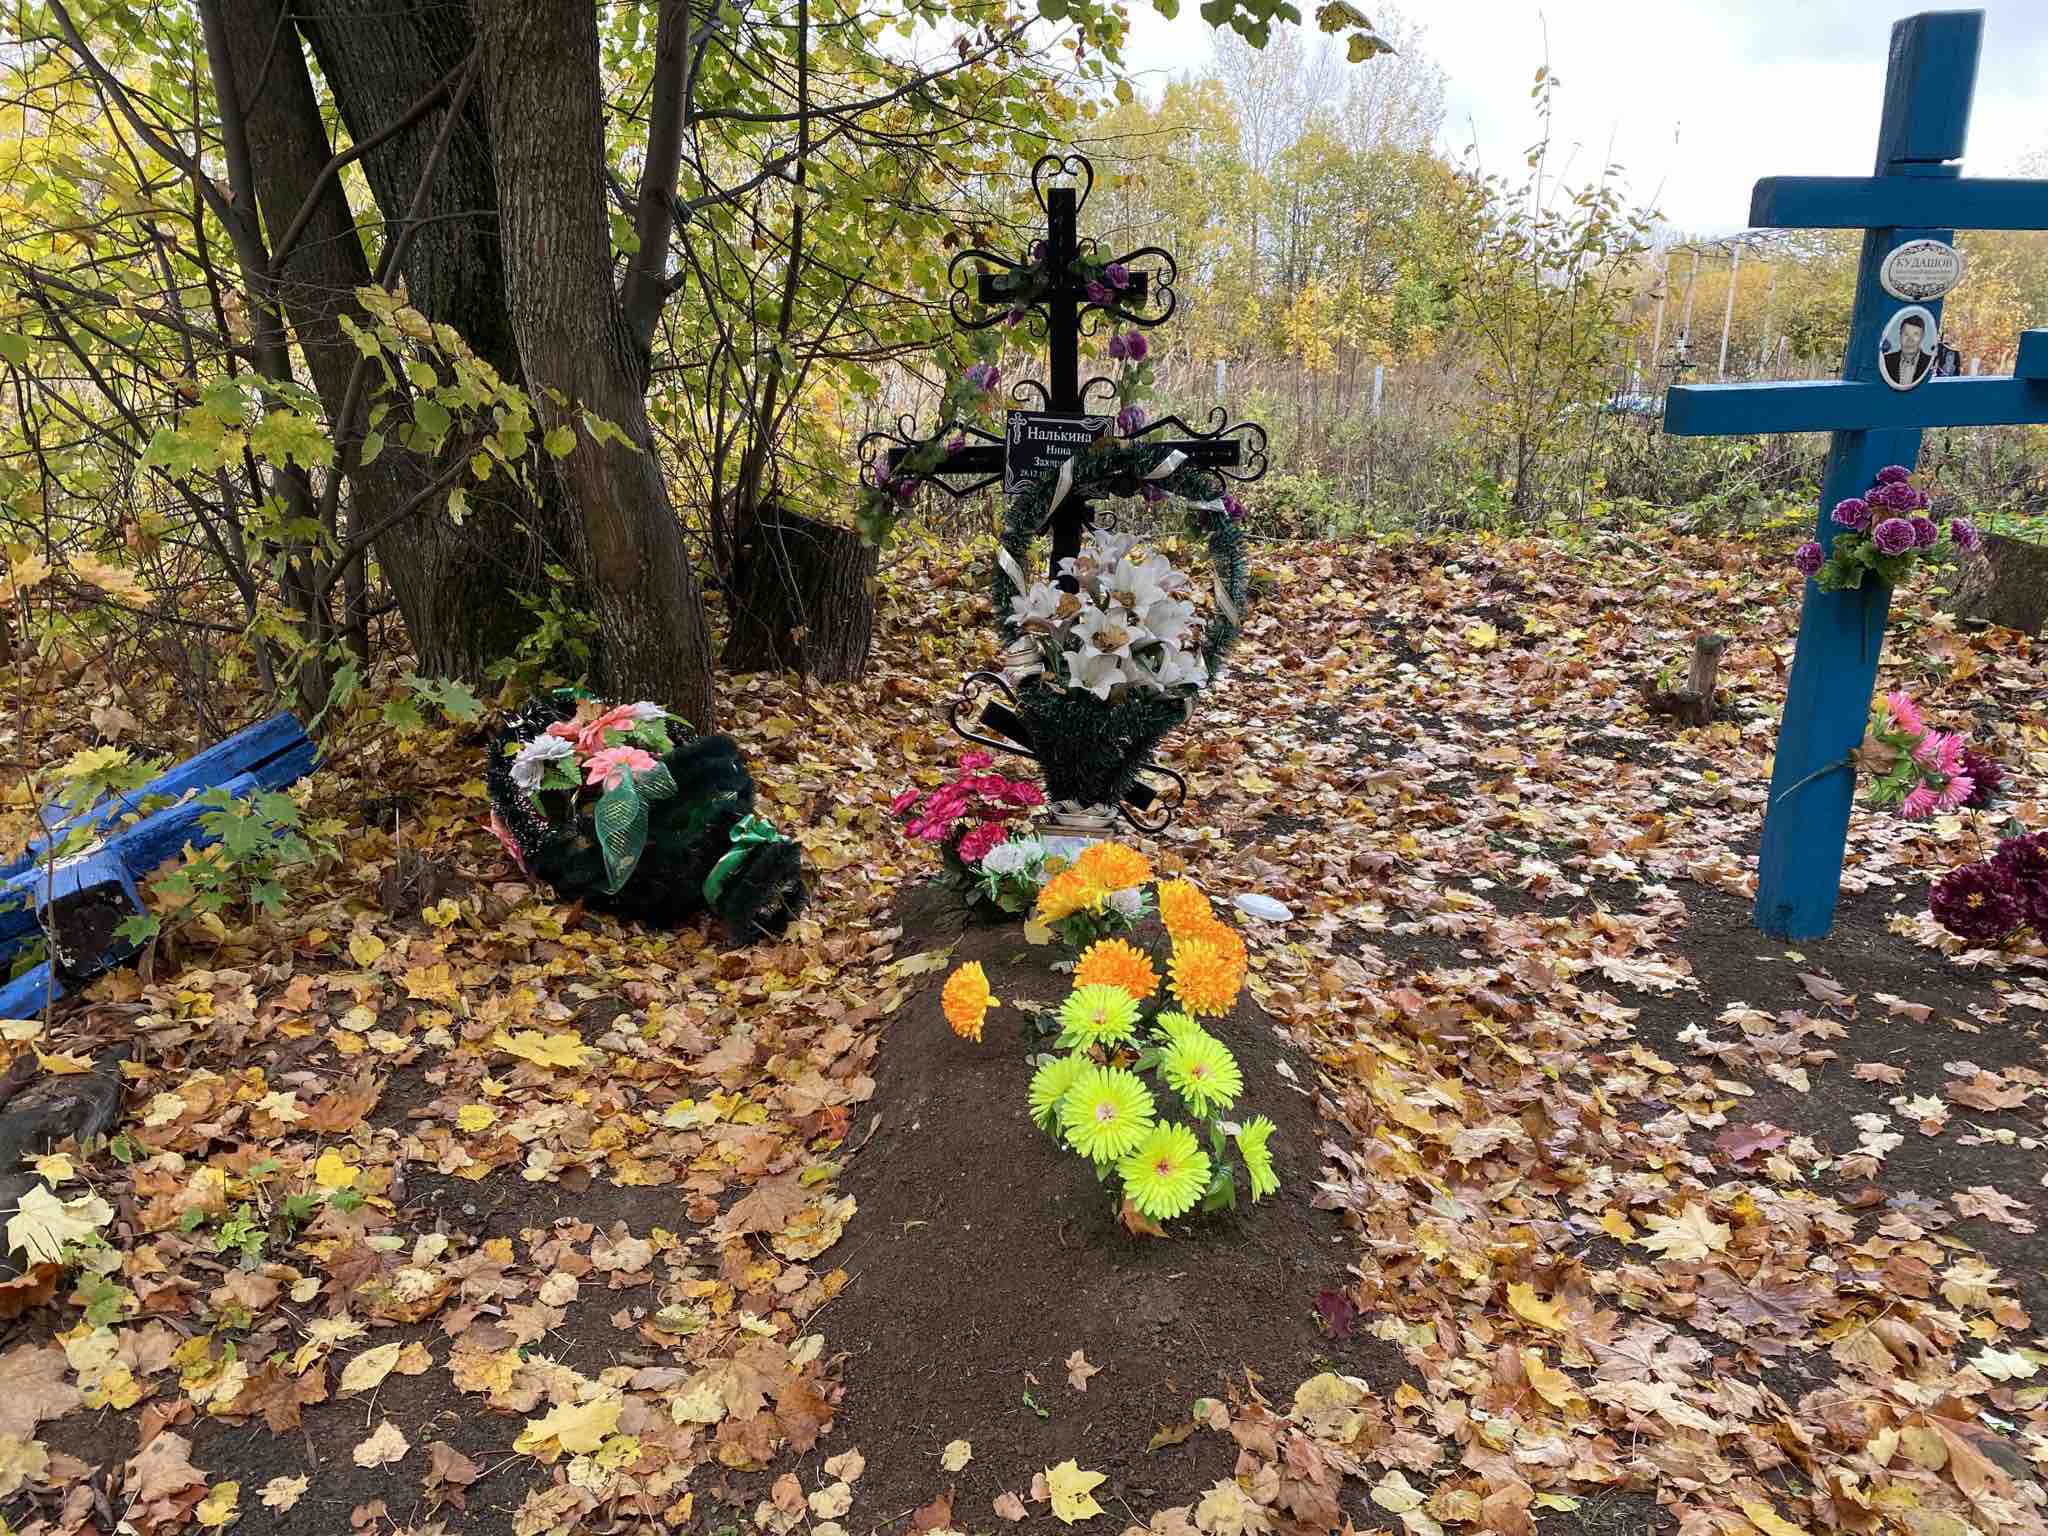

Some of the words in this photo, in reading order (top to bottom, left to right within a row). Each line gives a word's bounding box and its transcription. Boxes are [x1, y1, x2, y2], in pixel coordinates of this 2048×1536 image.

[1896, 256, 1953, 268] КУДАШОВ
[1027, 426, 1092, 443] Налькина
[1046, 444, 1071, 455] Нина
